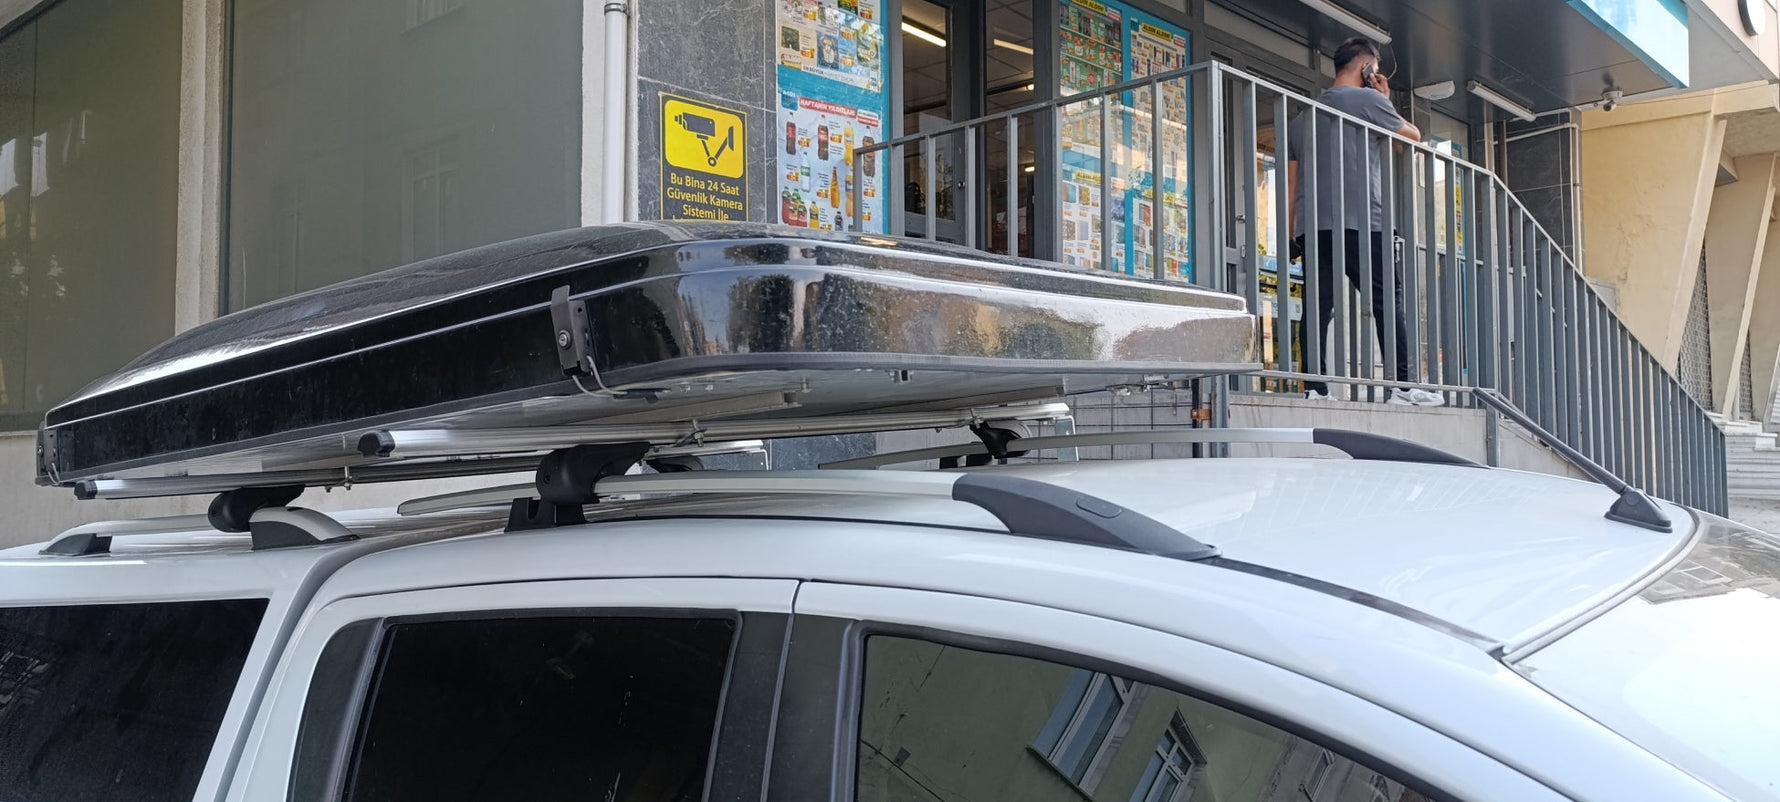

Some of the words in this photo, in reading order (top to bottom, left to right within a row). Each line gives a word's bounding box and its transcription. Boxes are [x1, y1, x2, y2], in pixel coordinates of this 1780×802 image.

[670, 172, 683, 185] Bu
[685, 175, 705, 189] Bina
[707, 180, 719, 192] 24
[720, 182, 740, 196] Saat
[666, 187, 708, 204] Güvenlik
[709, 194, 743, 211] Kamera
[682, 203, 716, 220] Sistemi
